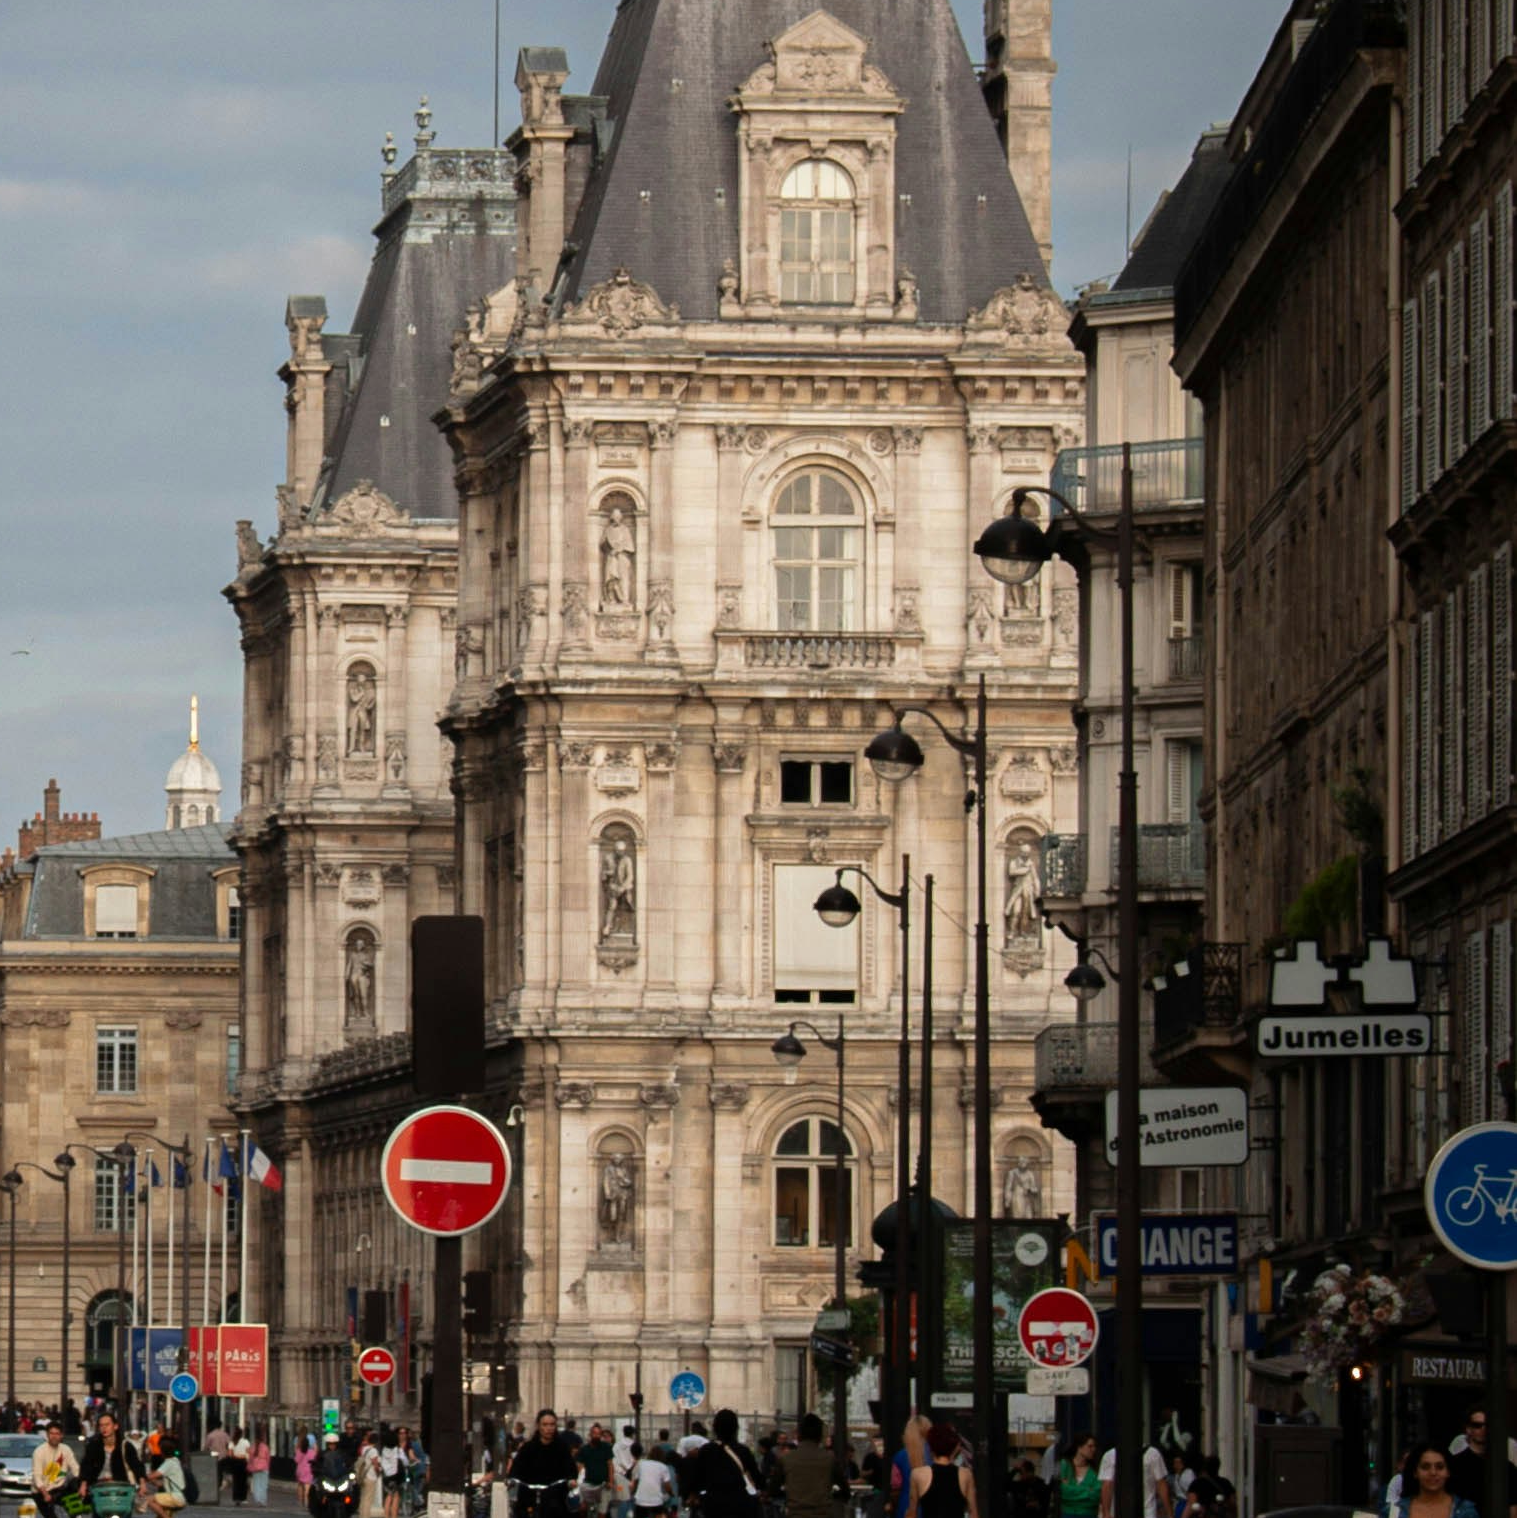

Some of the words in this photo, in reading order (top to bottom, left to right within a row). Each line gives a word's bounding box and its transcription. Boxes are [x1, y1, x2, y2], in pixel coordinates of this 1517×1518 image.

[1263, 1024, 1425, 1050] Jumelles
[1154, 1102, 1219, 1123] maison
[1138, 1118, 1245, 1147] 'Astronomie
[1044, 1370, 1071, 1380] SAUF
[1412, 1356, 1485, 1380] RESTAURA
